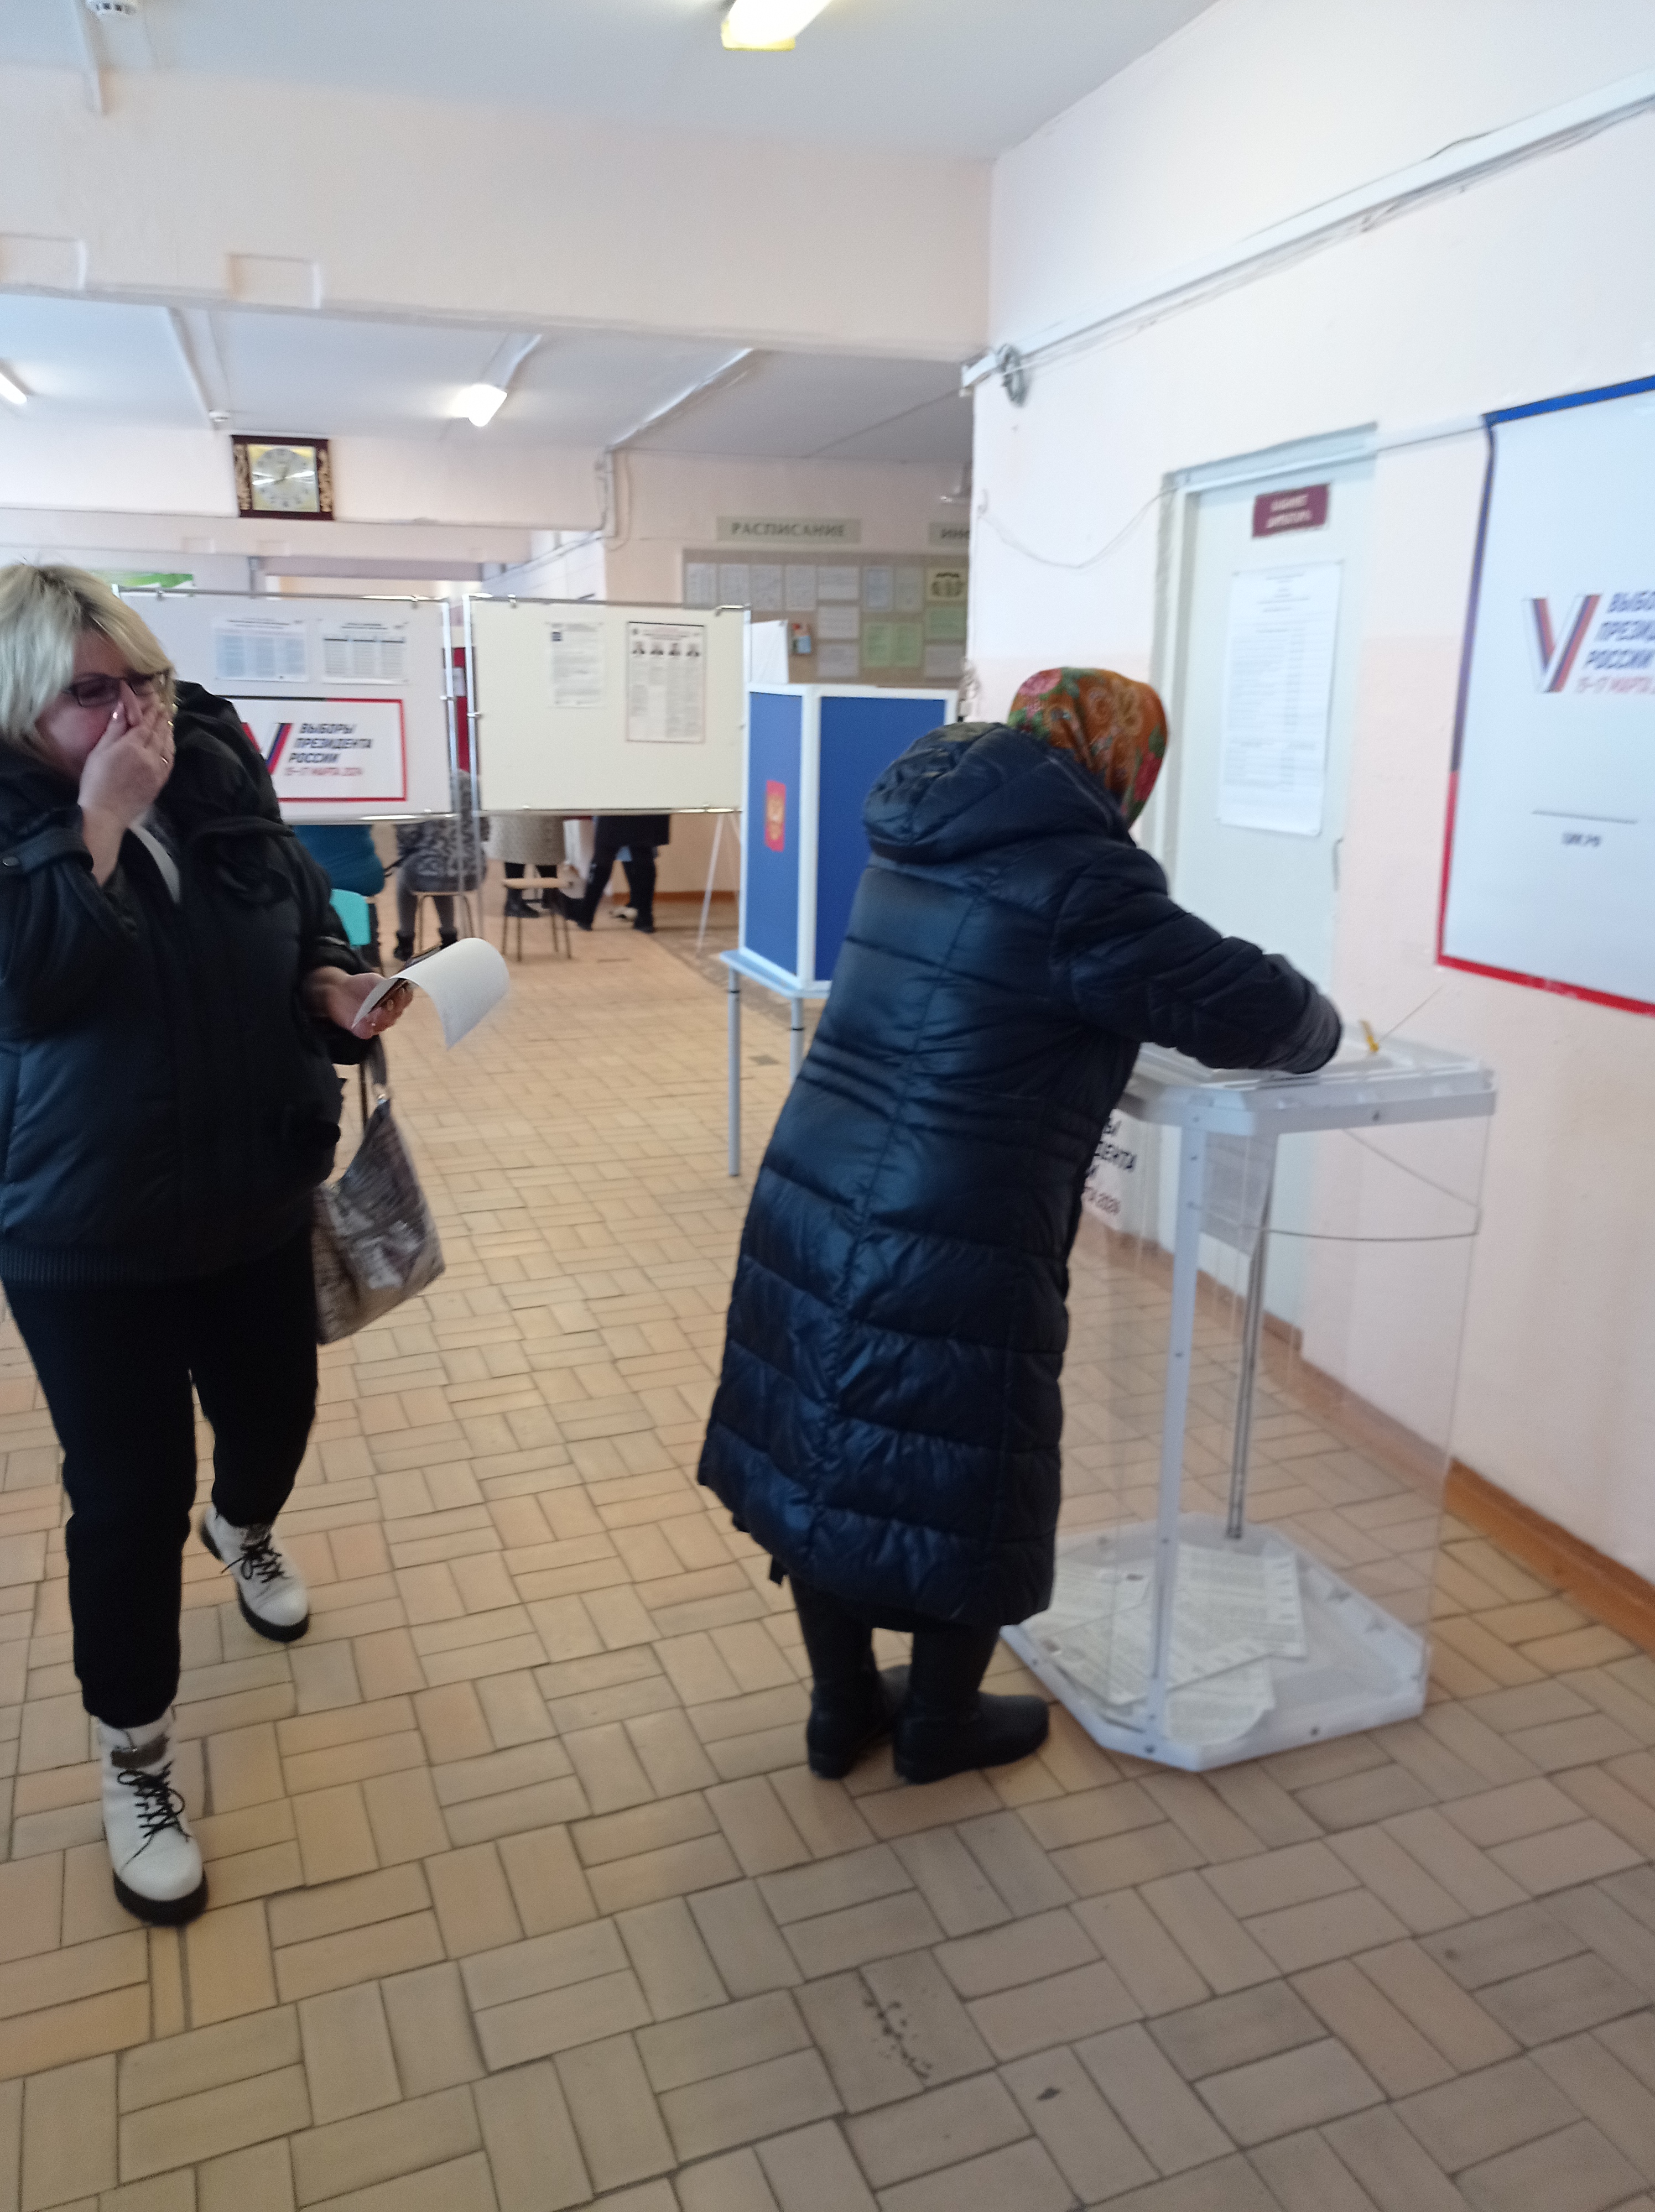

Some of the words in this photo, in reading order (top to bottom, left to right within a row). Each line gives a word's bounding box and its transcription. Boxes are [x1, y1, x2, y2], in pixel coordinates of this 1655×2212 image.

[731, 523, 845, 537] РАСПИСАНИЕ
[299, 723, 357, 734] ВЫБОРЫ
[294, 738, 373, 749] ПРЕЗИДЕНТА
[288, 753, 341, 763] РОССИИ
